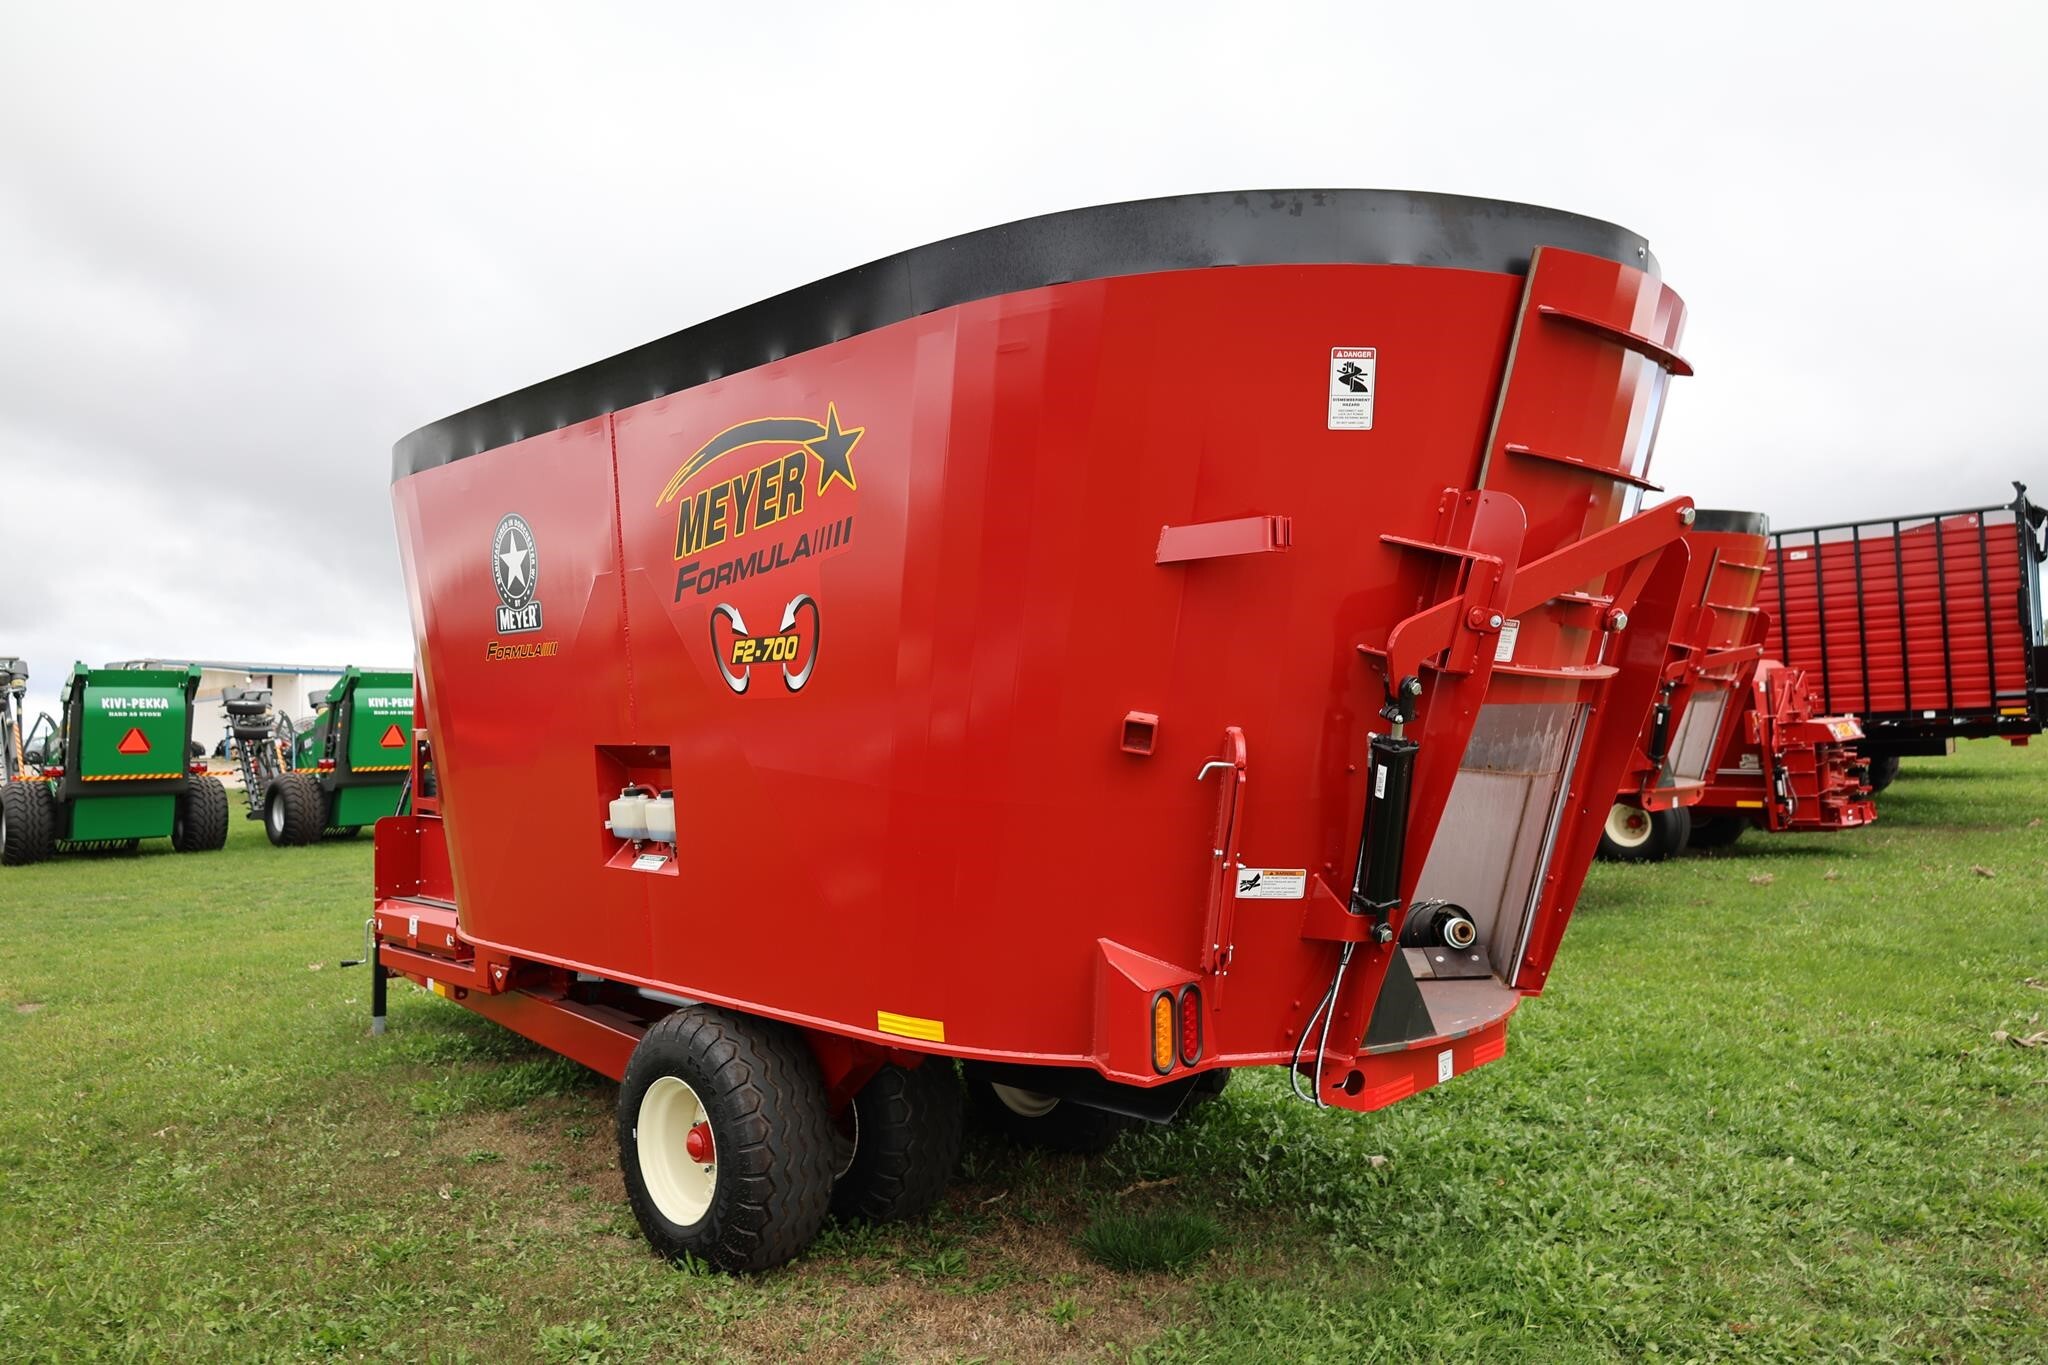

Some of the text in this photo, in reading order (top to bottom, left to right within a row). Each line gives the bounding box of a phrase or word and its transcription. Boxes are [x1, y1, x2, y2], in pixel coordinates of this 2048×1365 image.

[1343, 350, 1372, 358] DANGER
[674, 449, 808, 561] MEYER
[499, 604, 538, 631] MEYER
[731, 634, 799, 664] F2-700
[101, 697, 169, 710] KIVI-PEKKA
[368, 697, 414, 708] KIVI-PEKK
